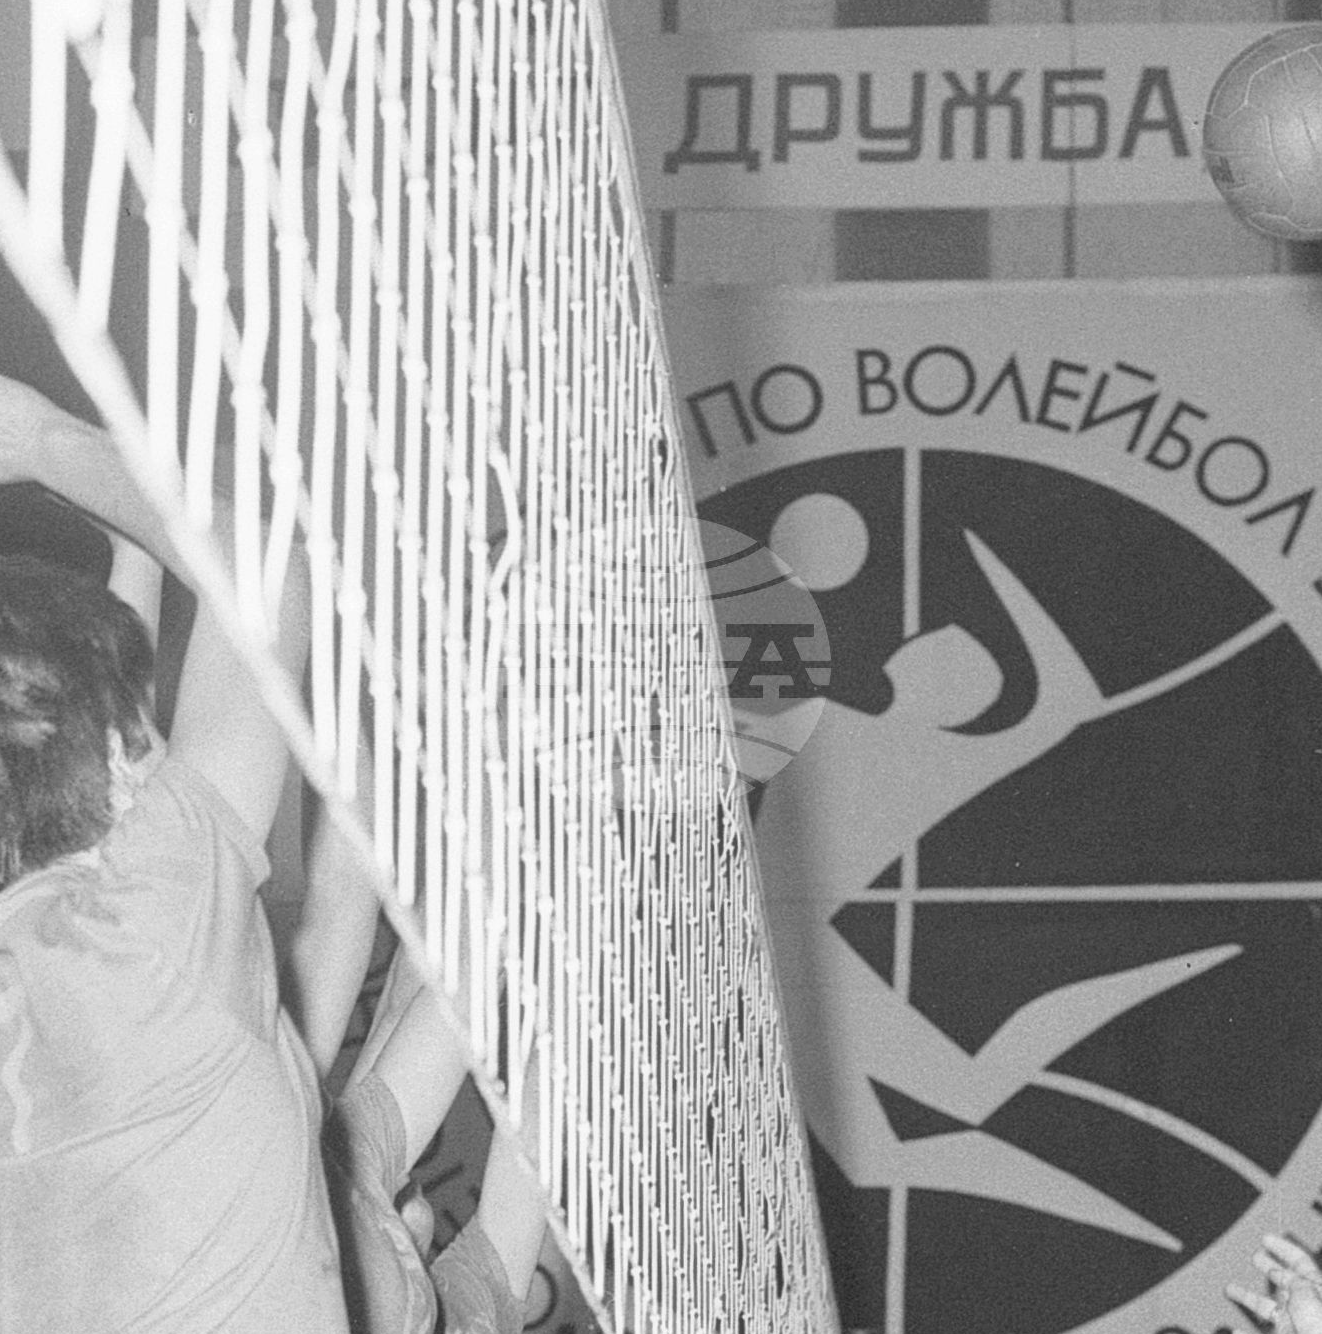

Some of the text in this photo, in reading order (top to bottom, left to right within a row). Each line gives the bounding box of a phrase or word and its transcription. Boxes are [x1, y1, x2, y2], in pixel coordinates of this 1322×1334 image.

[664, 67, 1191, 173] ДРУЖБА
[685, 363, 824, 460] ПО
[856, 344, 1315, 557] ВОЛЕЙБОЛ
